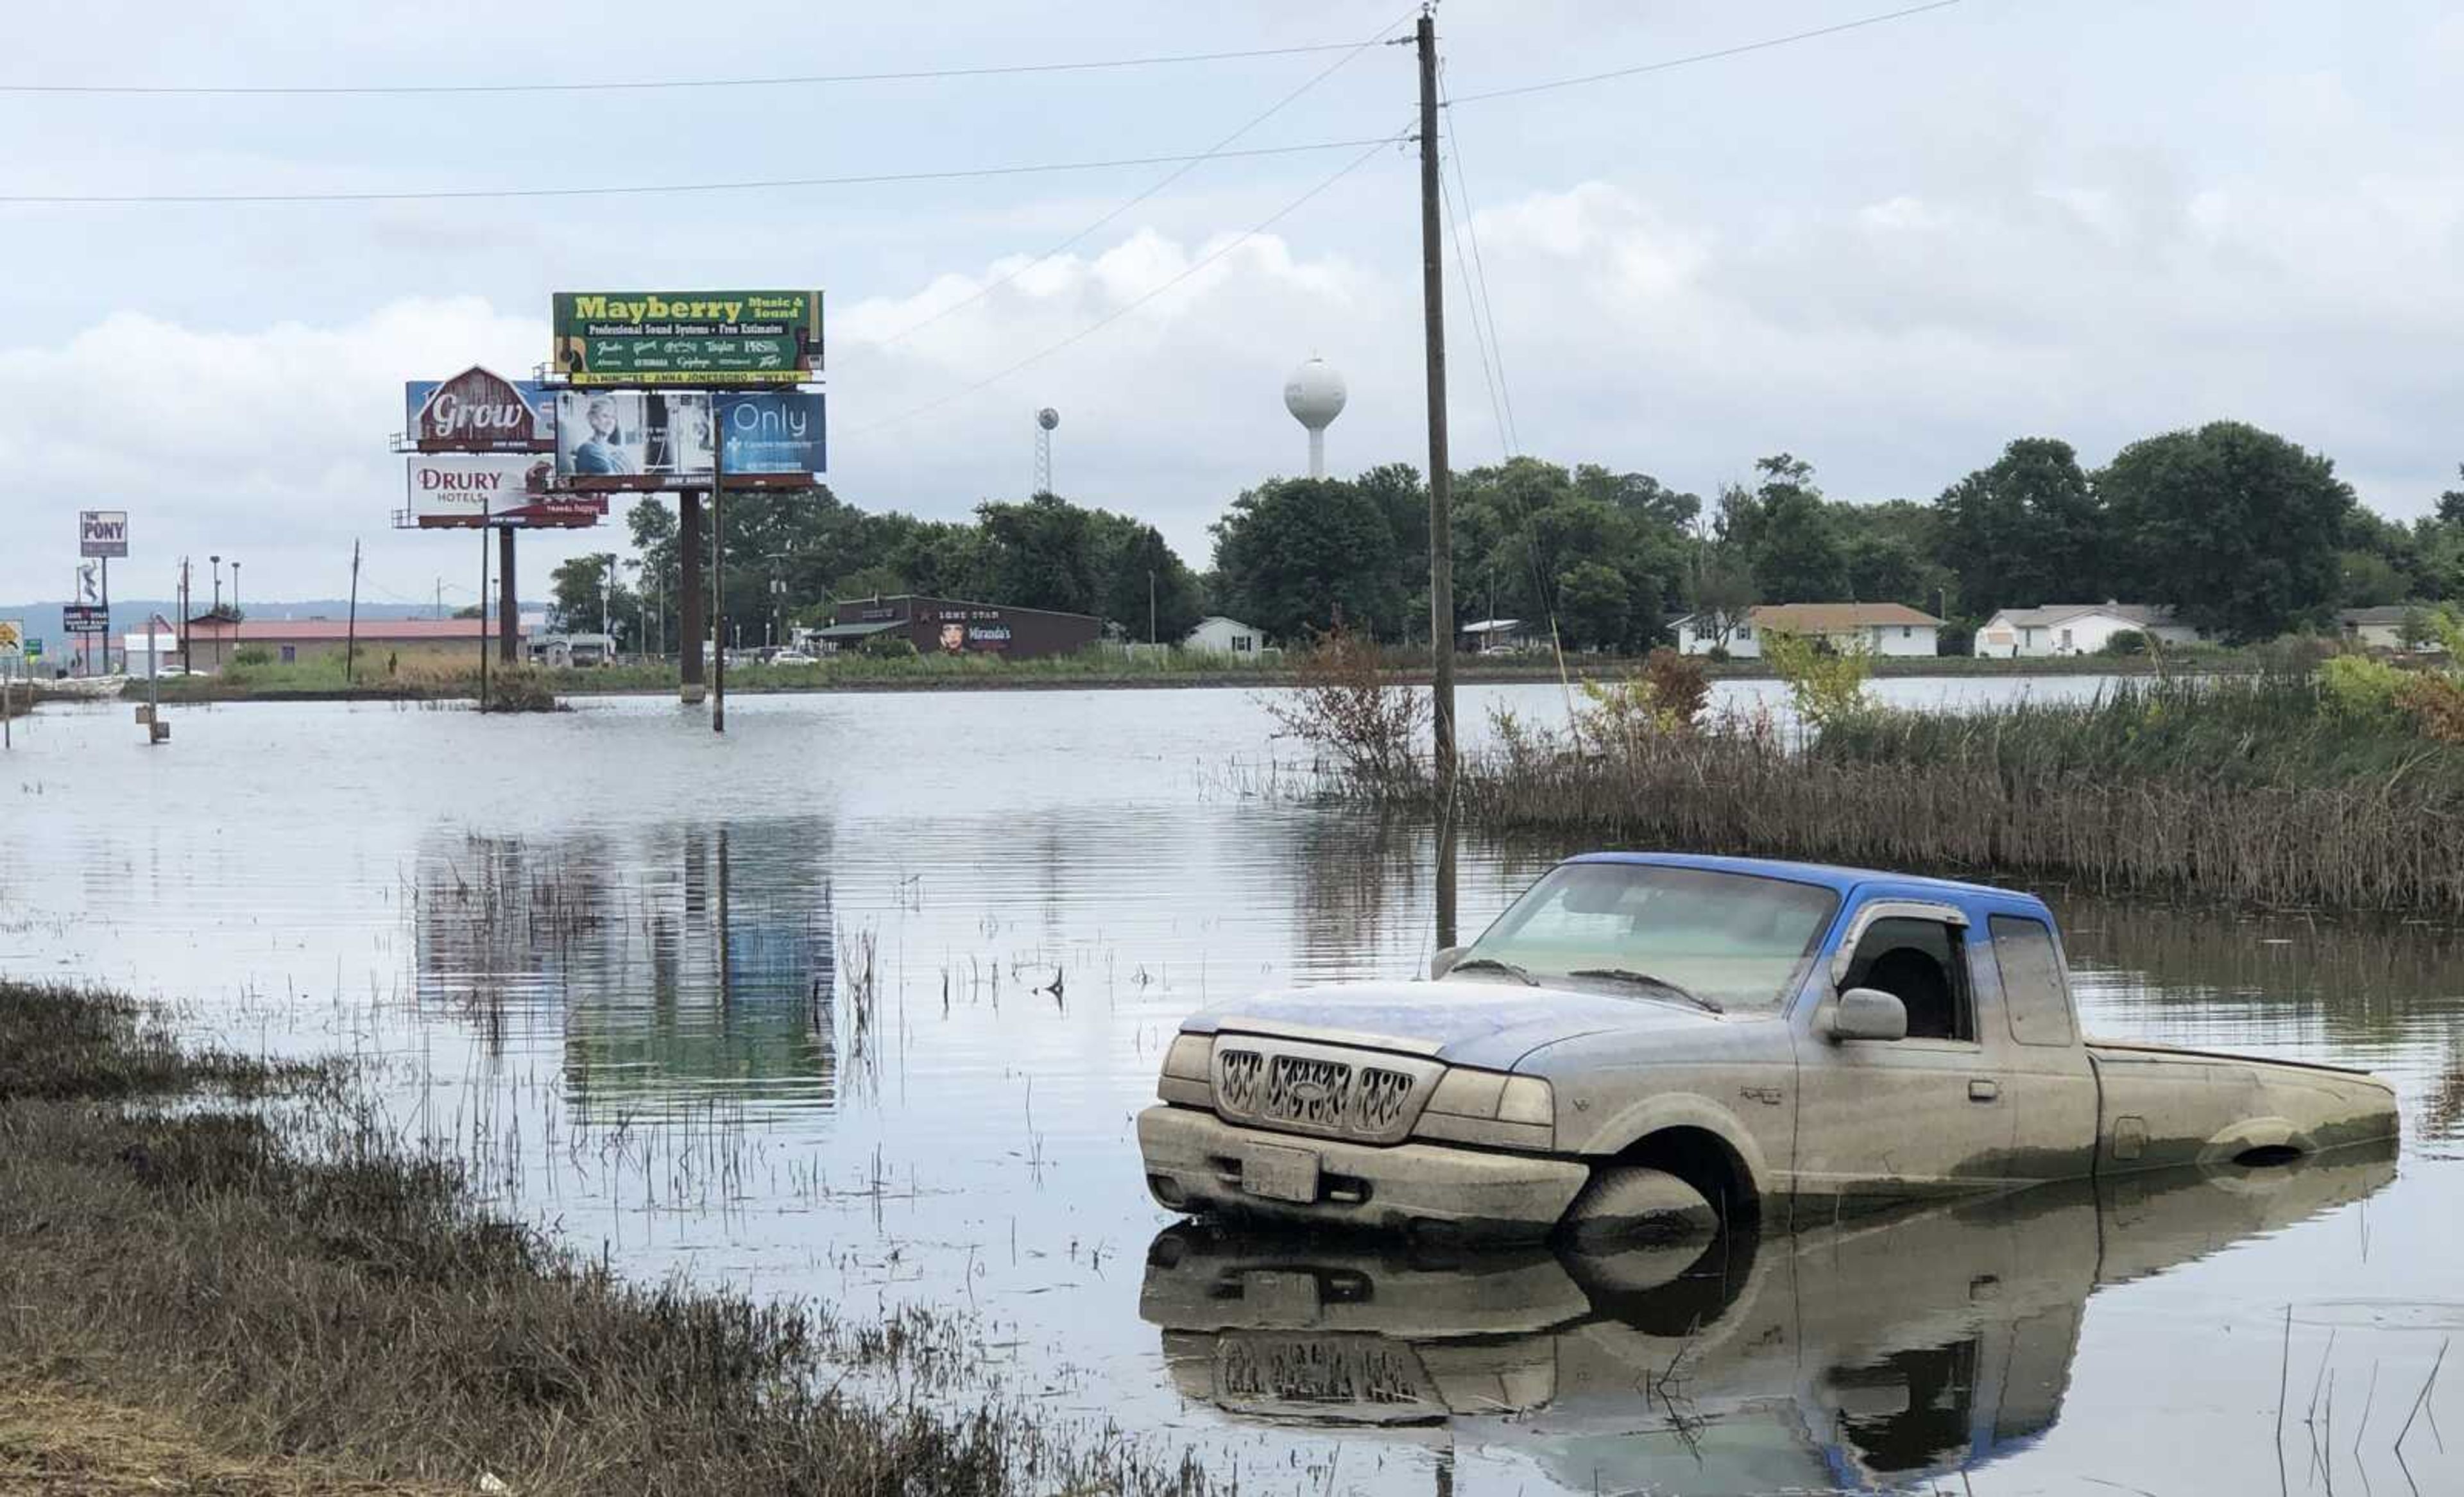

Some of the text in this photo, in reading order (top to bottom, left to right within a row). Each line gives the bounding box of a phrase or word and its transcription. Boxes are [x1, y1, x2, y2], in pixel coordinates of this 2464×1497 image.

[576, 296, 803, 323] Mayberry Music &
[753, 308, 799, 318] Sound
[589, 324, 783, 337] Professional Sound Systems Free Estimates
[432, 394, 523, 437] Grow
[734, 403, 807, 437] Only
[419, 468, 502, 490] DRURY
[438, 493, 483, 502] HOTELS
[85, 522, 124, 539] PONY
